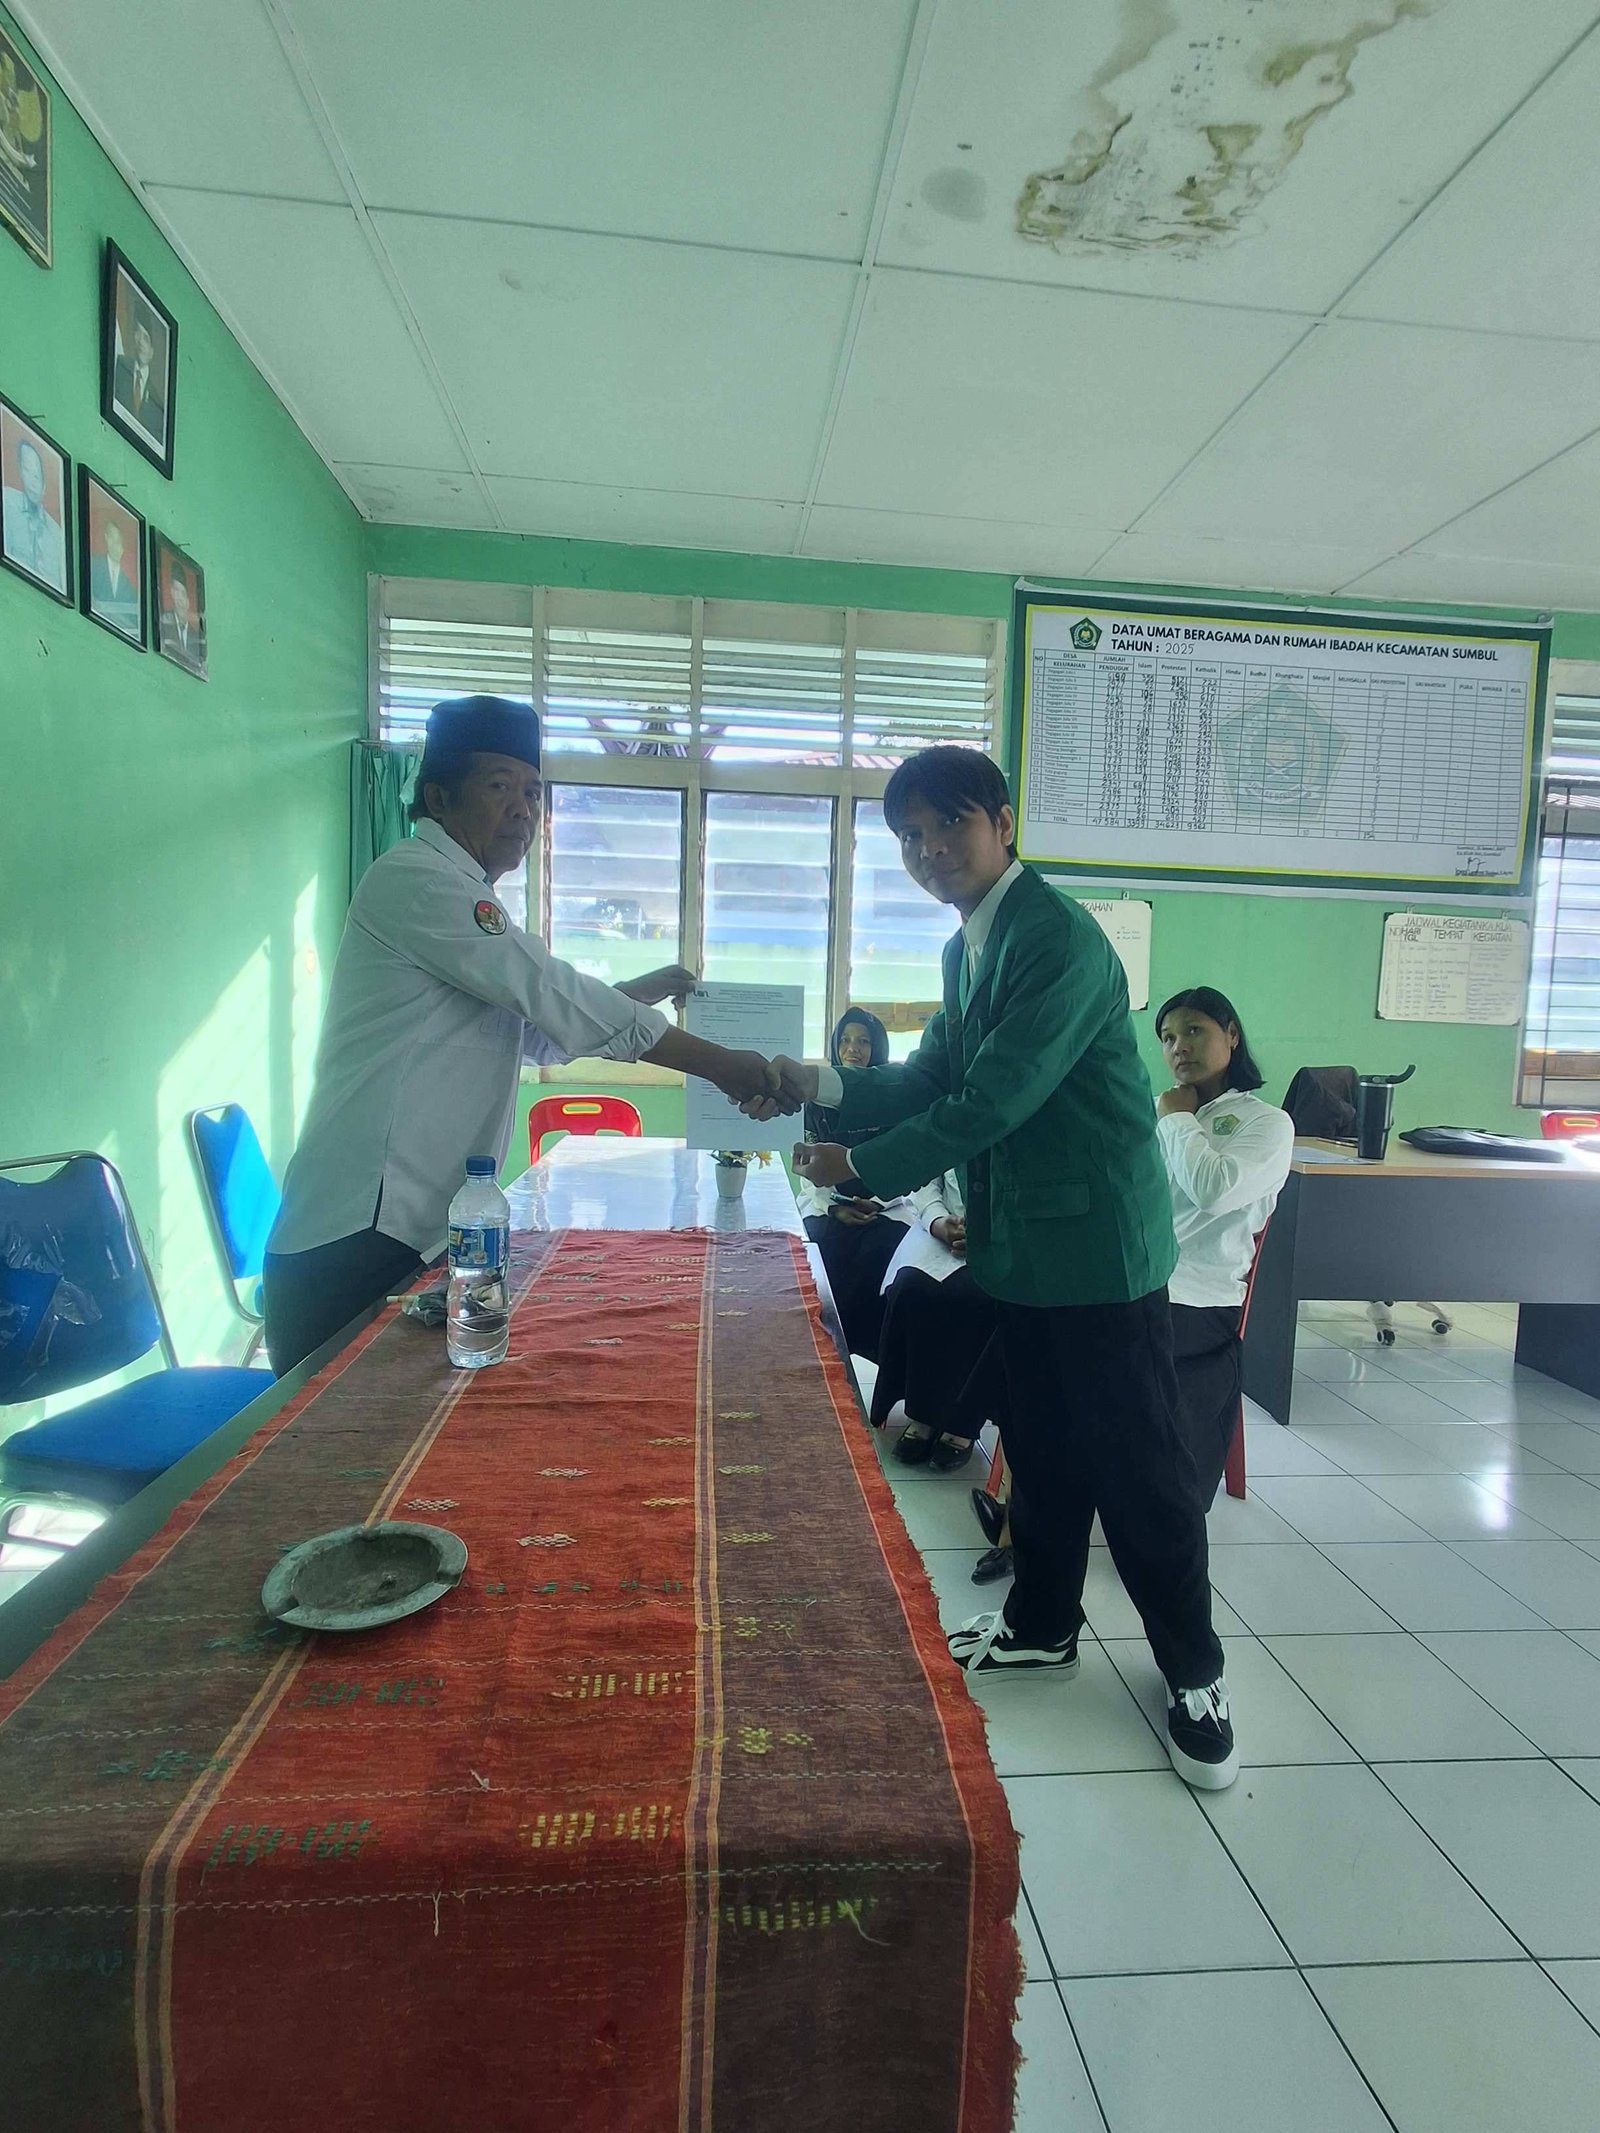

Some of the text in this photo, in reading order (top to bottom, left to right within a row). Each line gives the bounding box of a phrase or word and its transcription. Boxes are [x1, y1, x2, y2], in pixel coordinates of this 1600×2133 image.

[1111, 623, 1499, 661] DATA UMAT BERAGAMA DAN RUMAH IBADAH KECAMATAN SUMBUL
[1111, 638, 1153, 653] TAHUN
[1165, 642, 1195, 655] 2025
[1102, 655, 1126, 663] JUMLAH
[1053, 660, 1087, 669] KELURAHAN
[1098, 664, 1130, 672] PENDUDUK
[1161, 664, 1187, 672] Protestan
[1052, 815, 1069, 823] TOTAL
[1405, 917, 1443, 928] JADWAL
[1442, 918, 1484, 931] KEGIATAN
[1403, 934, 1419, 942] TGL
[1433, 929, 1465, 941] TEMPAT
[1472, 932, 1513, 943] KEGIATAN
